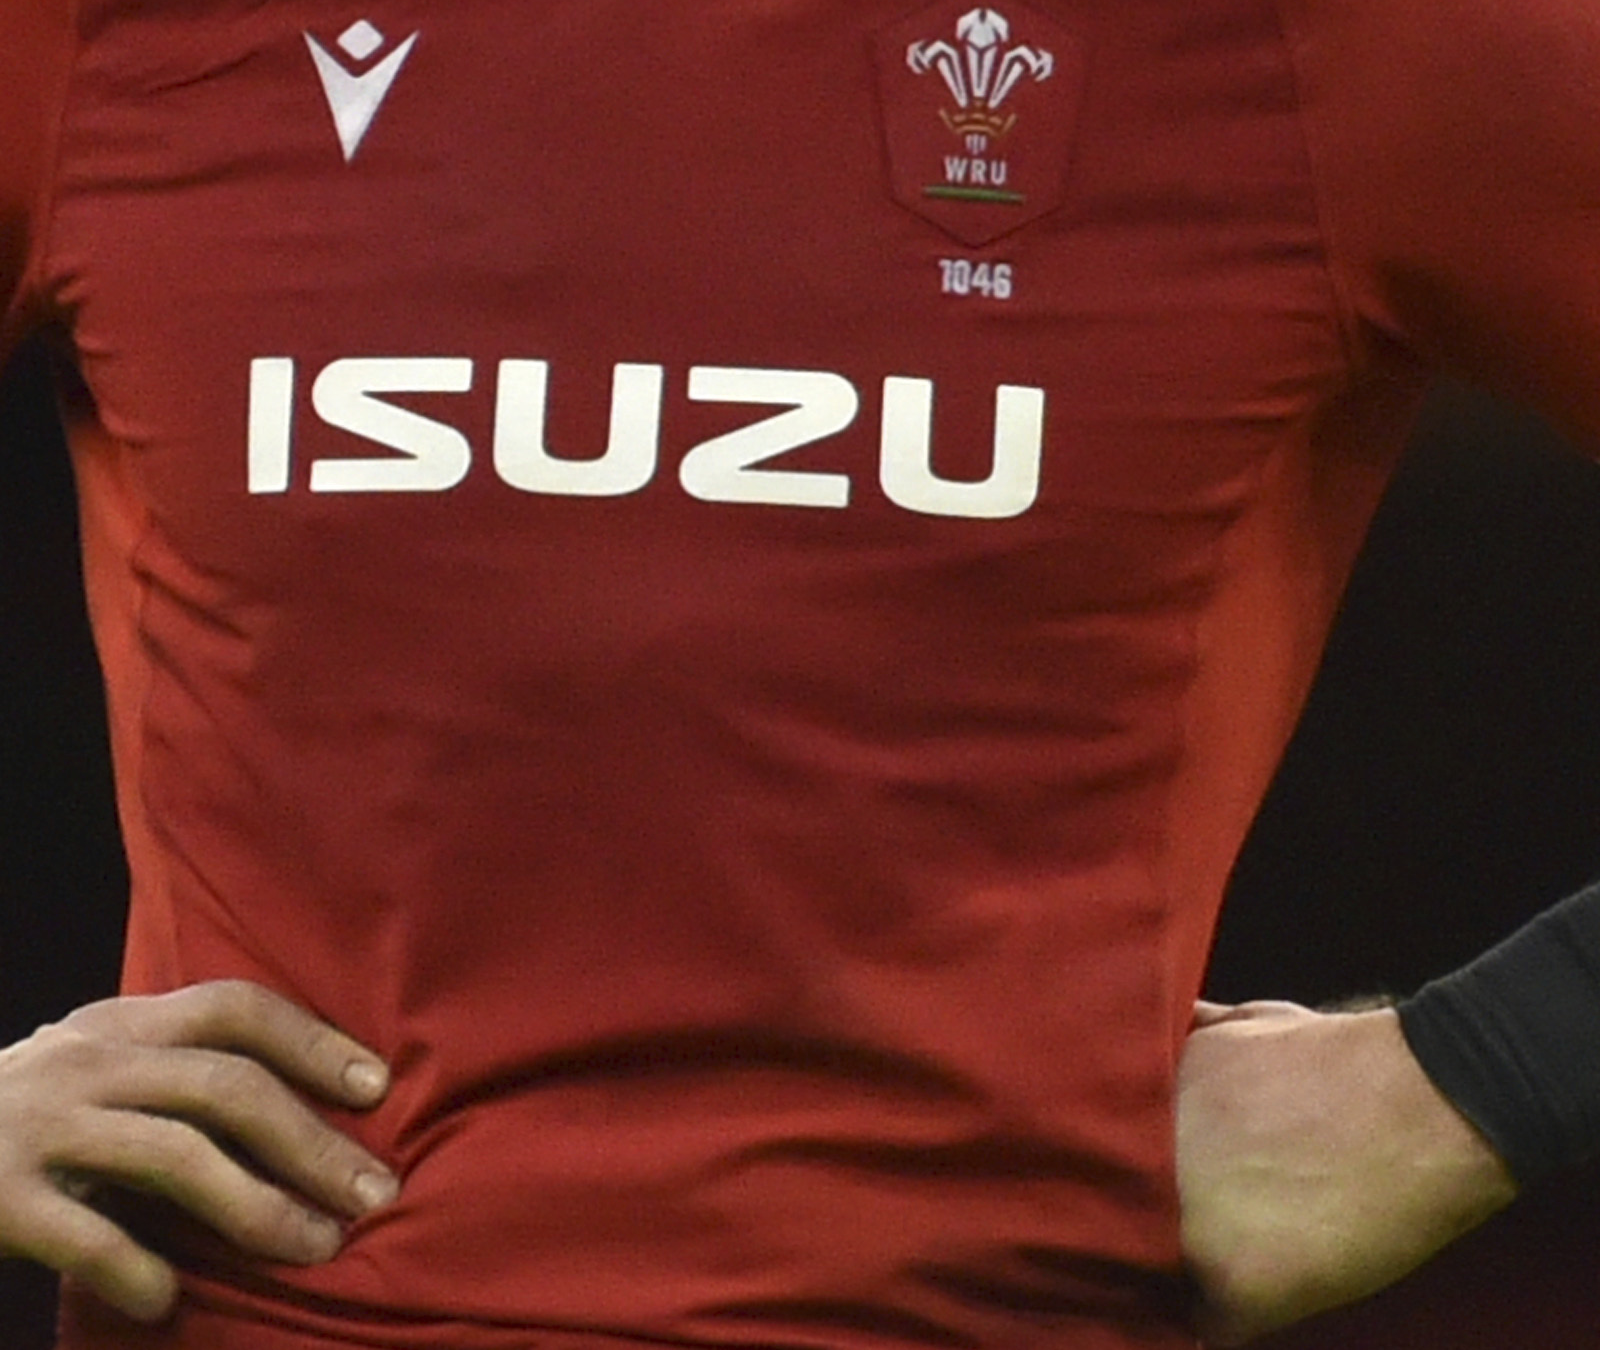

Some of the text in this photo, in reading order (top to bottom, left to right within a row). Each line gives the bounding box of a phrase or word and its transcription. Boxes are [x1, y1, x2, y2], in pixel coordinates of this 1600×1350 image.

[943, 155, 1007, 185] WRU
[938, 258, 1013, 302] 1046
[247, 356, 1045, 519] ISUZU
